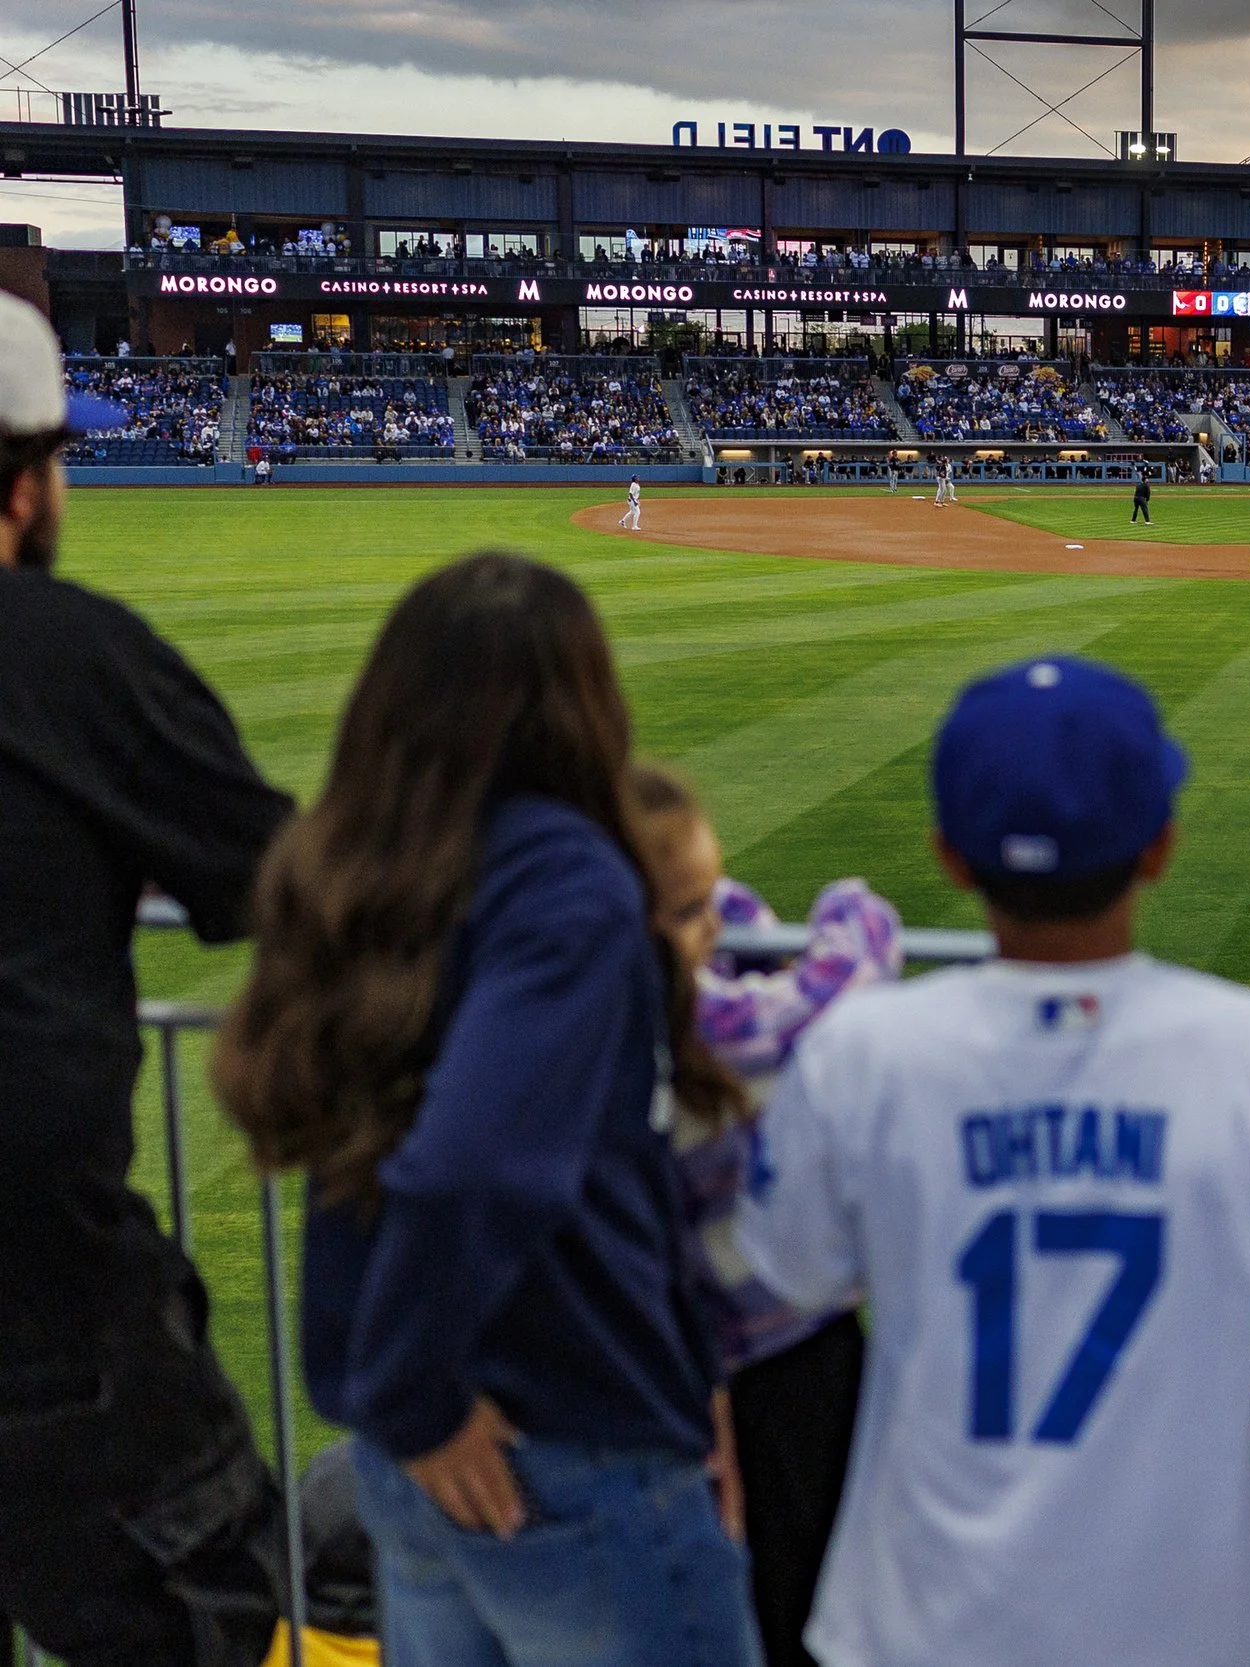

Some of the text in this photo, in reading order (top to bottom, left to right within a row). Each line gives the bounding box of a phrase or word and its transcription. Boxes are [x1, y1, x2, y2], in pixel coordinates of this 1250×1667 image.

[161, 275, 276, 293] MORONGO
[321, 281, 488, 295] CASINO RESORT SPA
[518, 280, 540, 300] M
[587, 284, 693, 301] MORONGO
[733, 290, 887, 302] CASINO RESORT SPA
[948, 288, 968, 308] M
[1029, 293, 1126, 309] MORONGO
[1196, 296, 1206, 310] 0
[1217, 296, 1228, 311] 0
[960, 1104, 1169, 1190] OHTANI
[955, 1210, 1165, 1444] 17
